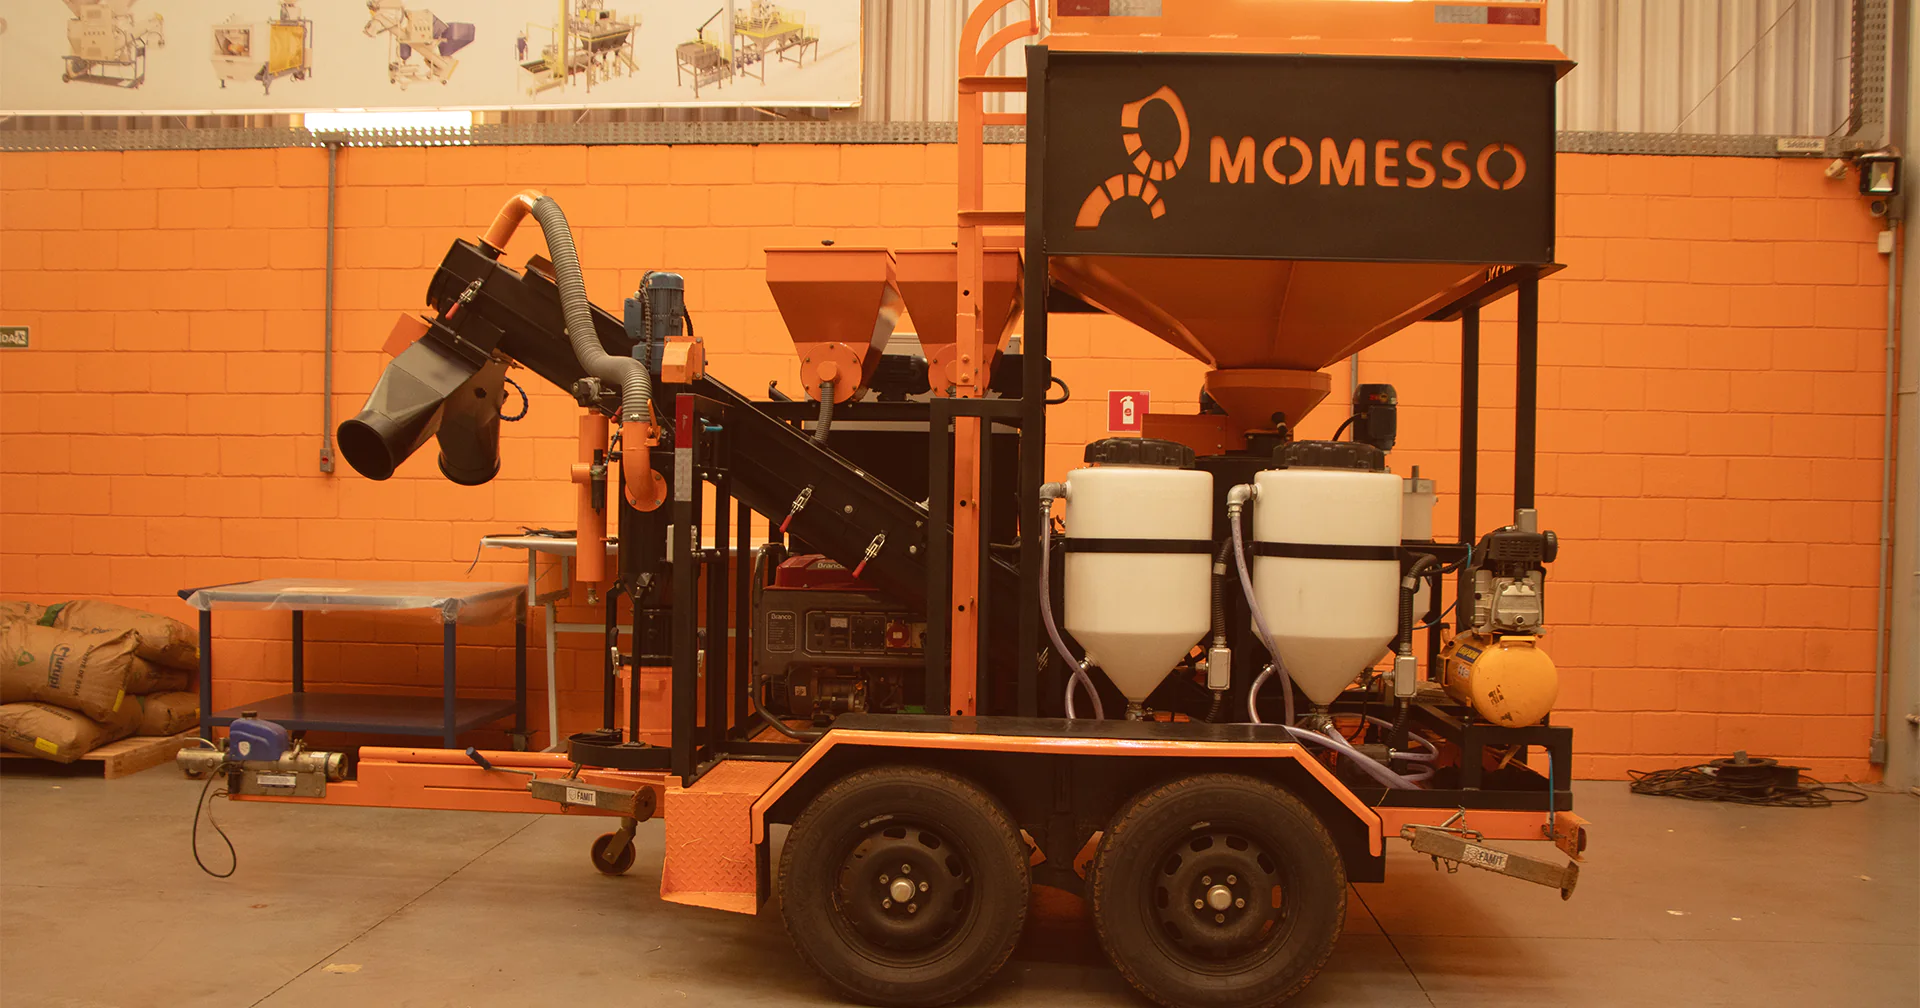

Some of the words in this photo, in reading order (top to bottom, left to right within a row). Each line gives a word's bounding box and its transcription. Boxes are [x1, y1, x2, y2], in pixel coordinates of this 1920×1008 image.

[1209, 135, 1527, 190] MOMESSO
[78, 668, 85, 680] DE
[73, 681, 83, 697] SOJA
[577, 791, 594, 802] FAMIT
[1479, 851, 1504, 866] FAMIT
